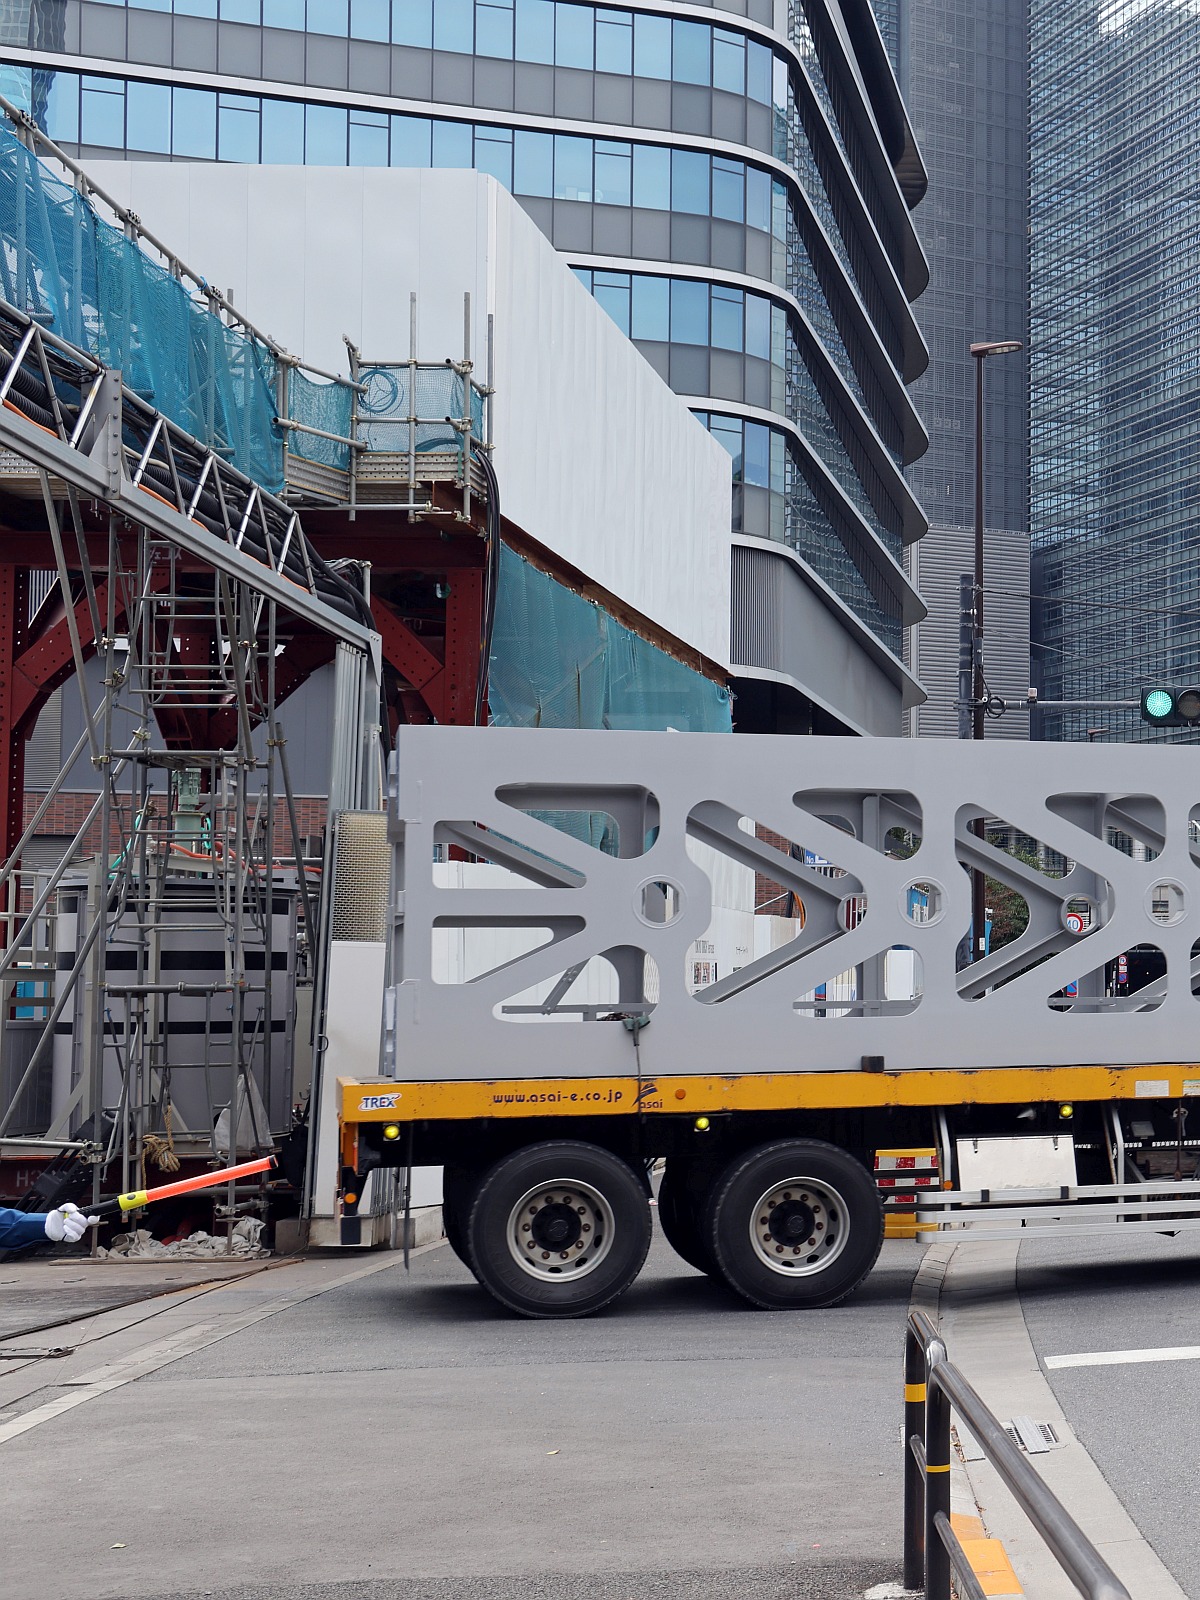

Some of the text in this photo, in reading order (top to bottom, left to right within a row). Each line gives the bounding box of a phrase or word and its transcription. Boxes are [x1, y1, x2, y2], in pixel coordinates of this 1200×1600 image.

[362, 1094, 398, 1109] TREX
[493, 1089, 623, 1104] www.asai-e.co.jp
[640, 1098, 663, 1109] asai
